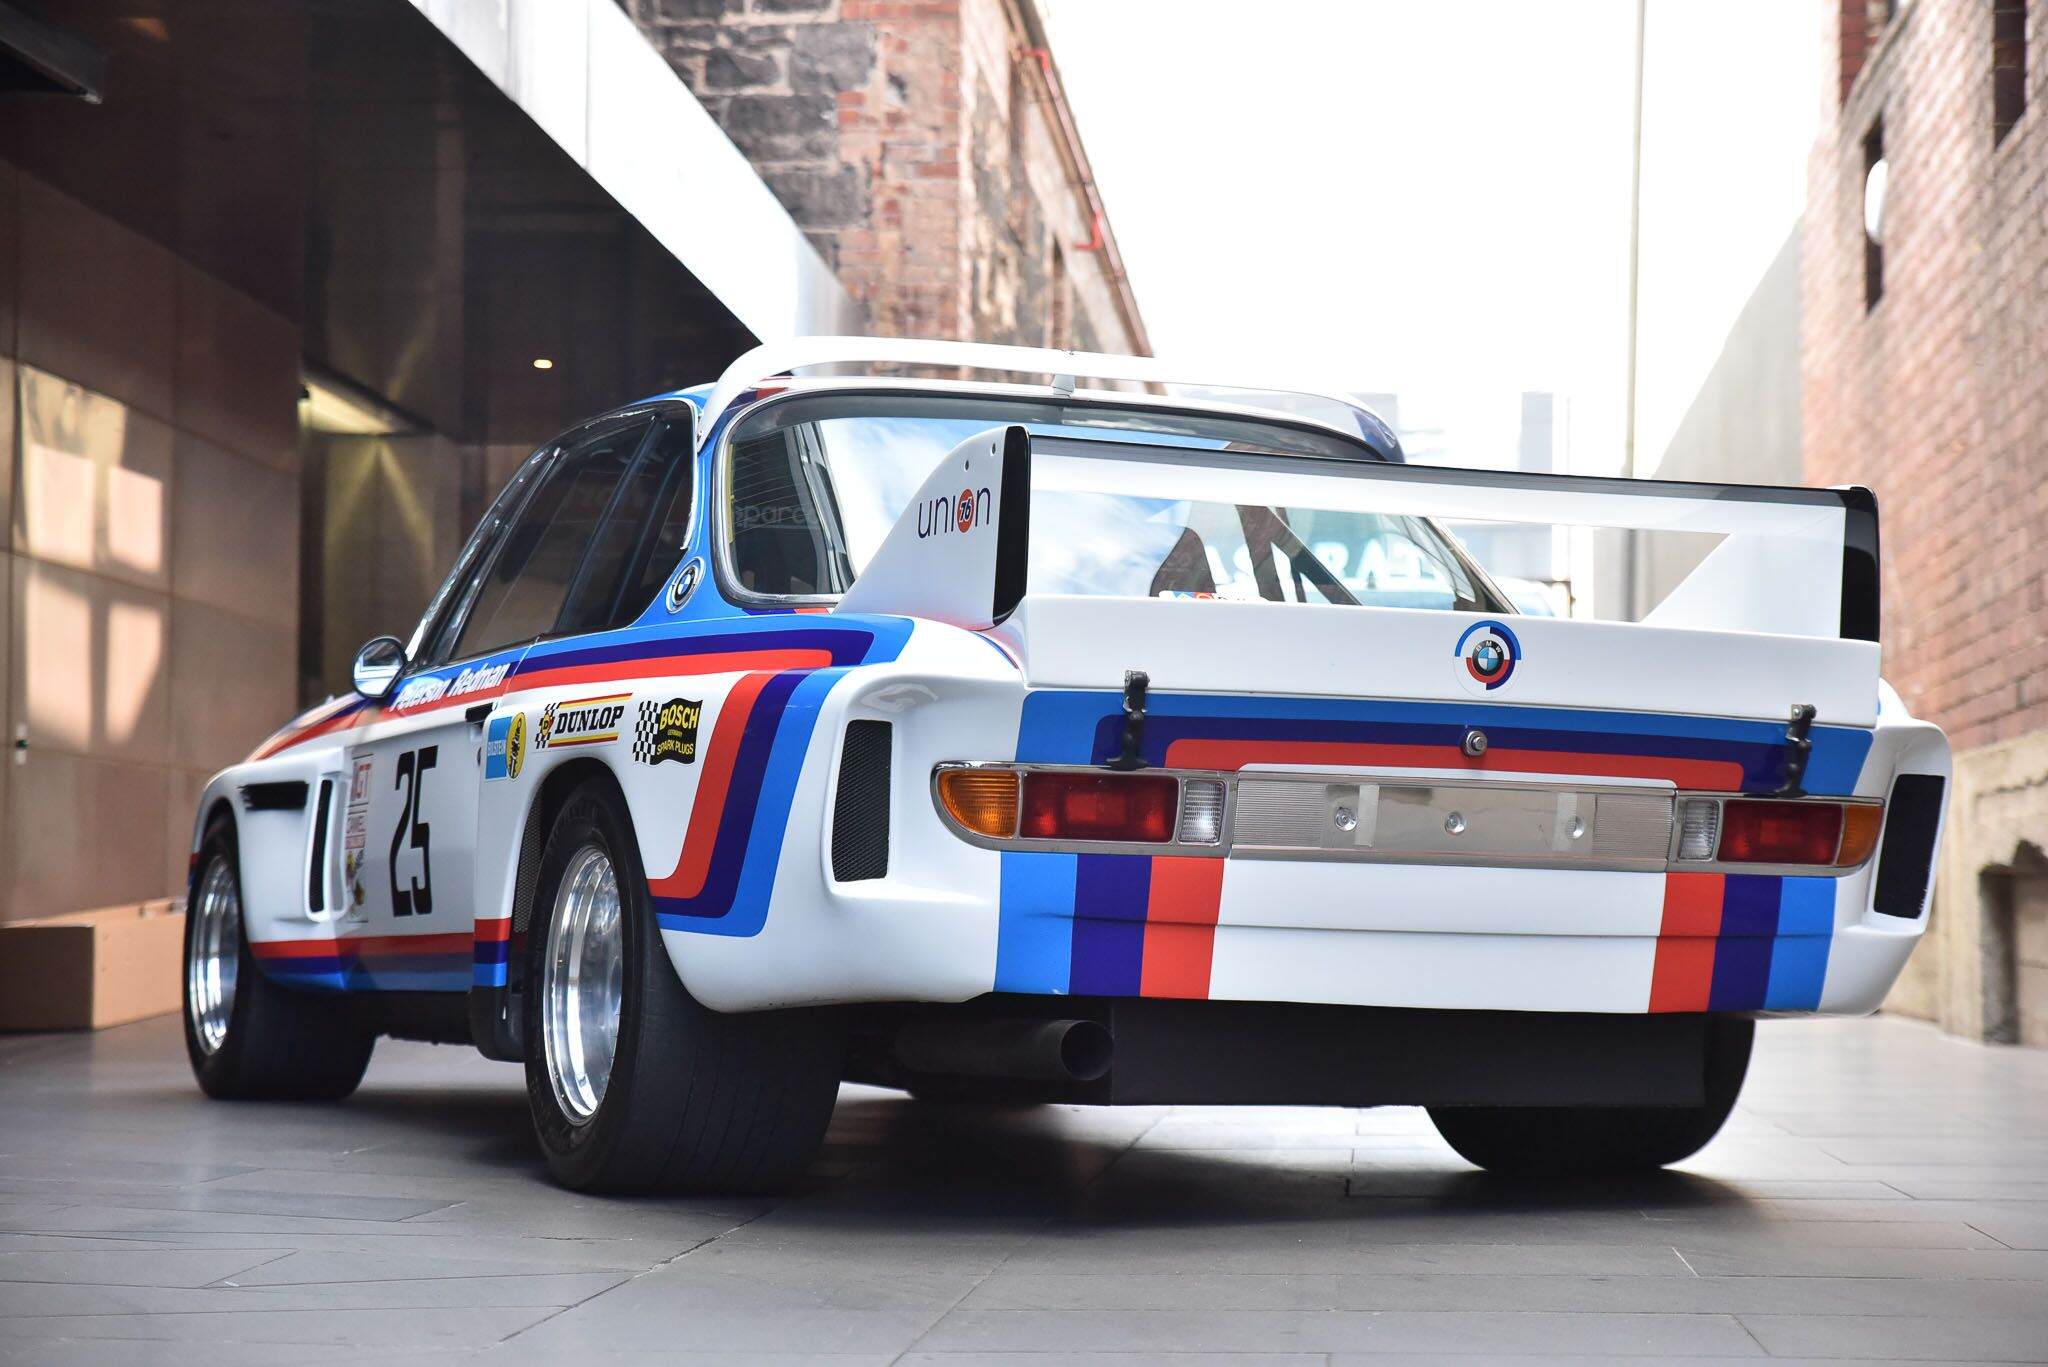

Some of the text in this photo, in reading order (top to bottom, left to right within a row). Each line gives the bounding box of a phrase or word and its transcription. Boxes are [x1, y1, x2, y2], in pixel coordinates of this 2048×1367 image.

[446, 663, 511, 698] Redman
[554, 705, 625, 734] DUNLOP
[659, 704, 700, 731] BOSCH
[657, 739, 694, 756] SPARK PLUGS
[385, 745, 439, 918] 25
